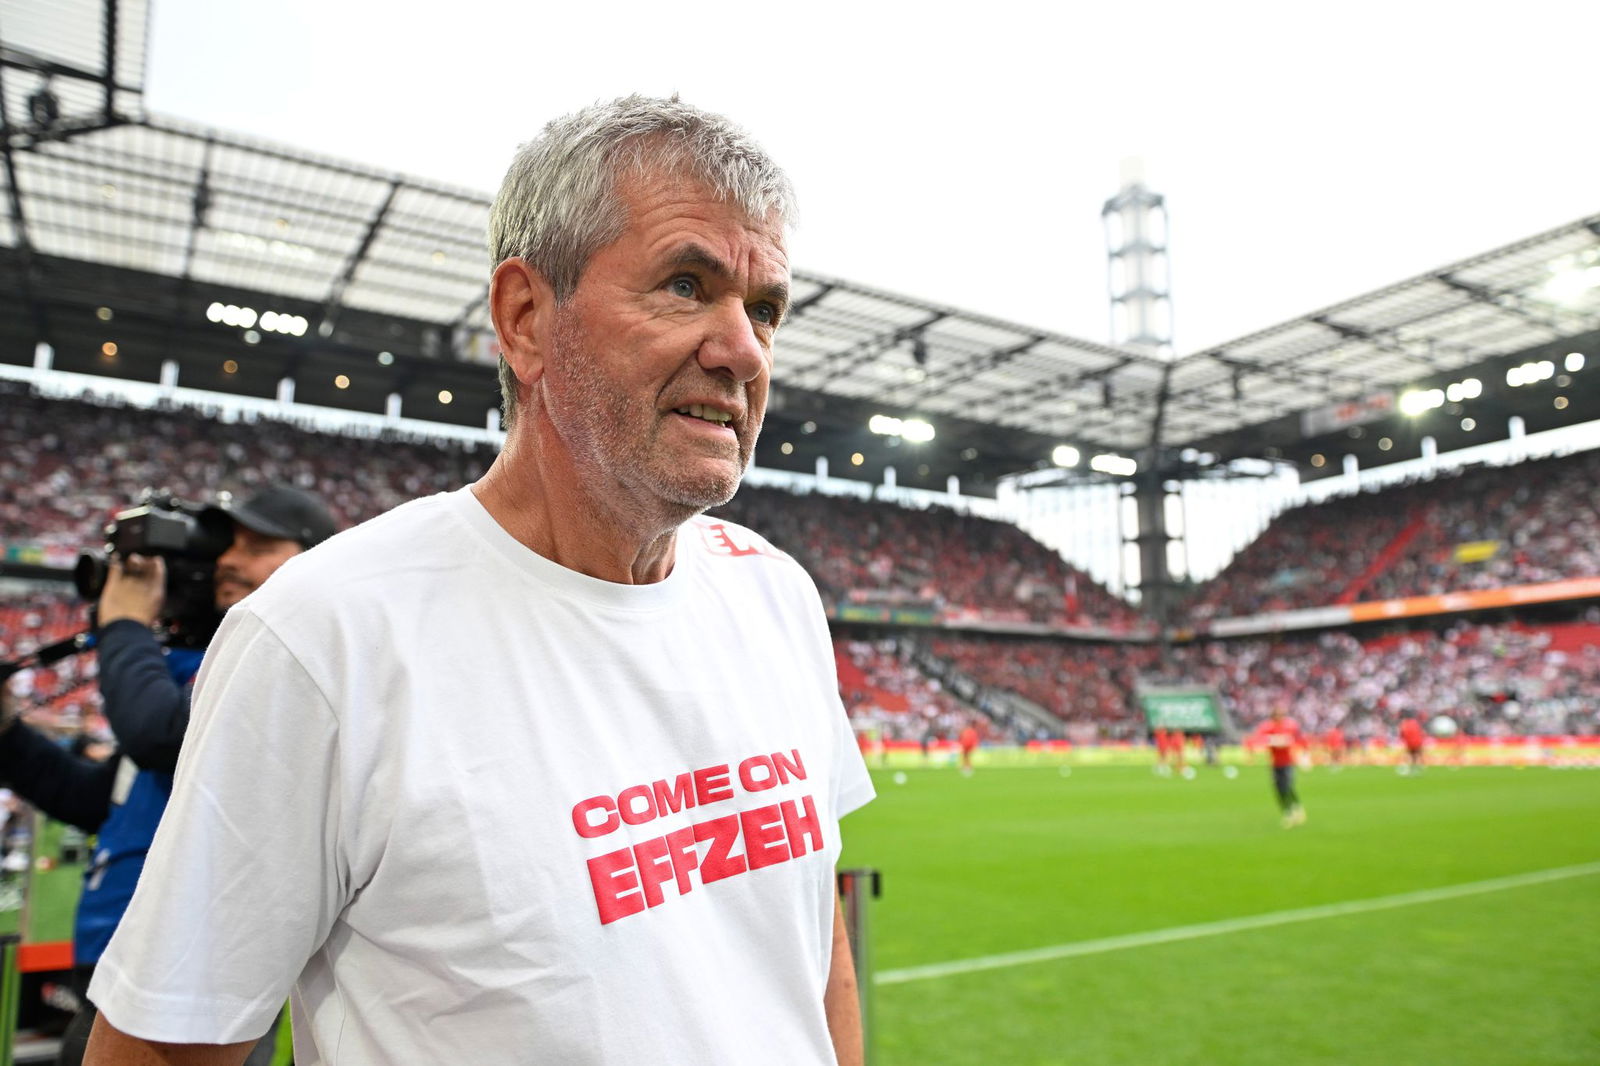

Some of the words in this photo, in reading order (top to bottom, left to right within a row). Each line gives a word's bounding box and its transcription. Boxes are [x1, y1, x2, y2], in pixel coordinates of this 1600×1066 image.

[571, 763, 734, 839] COME
[738, 749, 807, 793] ON
[586, 794, 824, 925] EFFZEH
